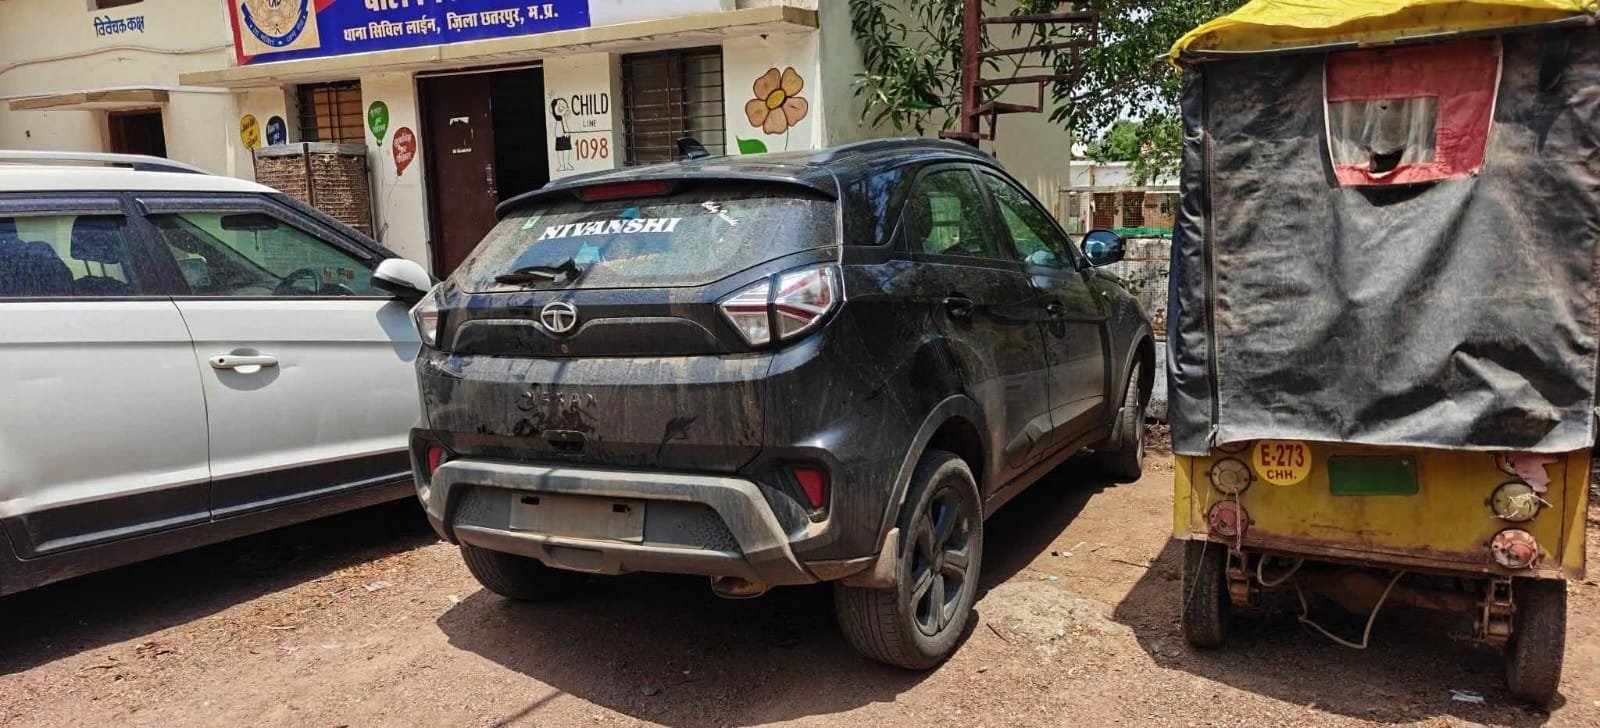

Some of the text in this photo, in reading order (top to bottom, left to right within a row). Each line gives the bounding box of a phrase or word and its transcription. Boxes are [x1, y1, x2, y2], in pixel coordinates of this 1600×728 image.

[93, 15, 145, 38] विवेचक कक्ष
[343, 26, 367, 42] थाना
[368, 20, 403, 39] सिविल
[405, 14, 441, 35] लाईन,
[480, 7, 525, 28] छतरपुर,
[527, 3, 559, 20] म.प्र.
[571, 92, 609, 116] CHILD
[582, 119, 597, 128] LINE
[575, 137, 609, 161] 1098
[537, 217, 682, 241] NIVANSHI
[1260, 443, 1305, 468] E-273
[1266, 469, 1297, 480] CHH.
